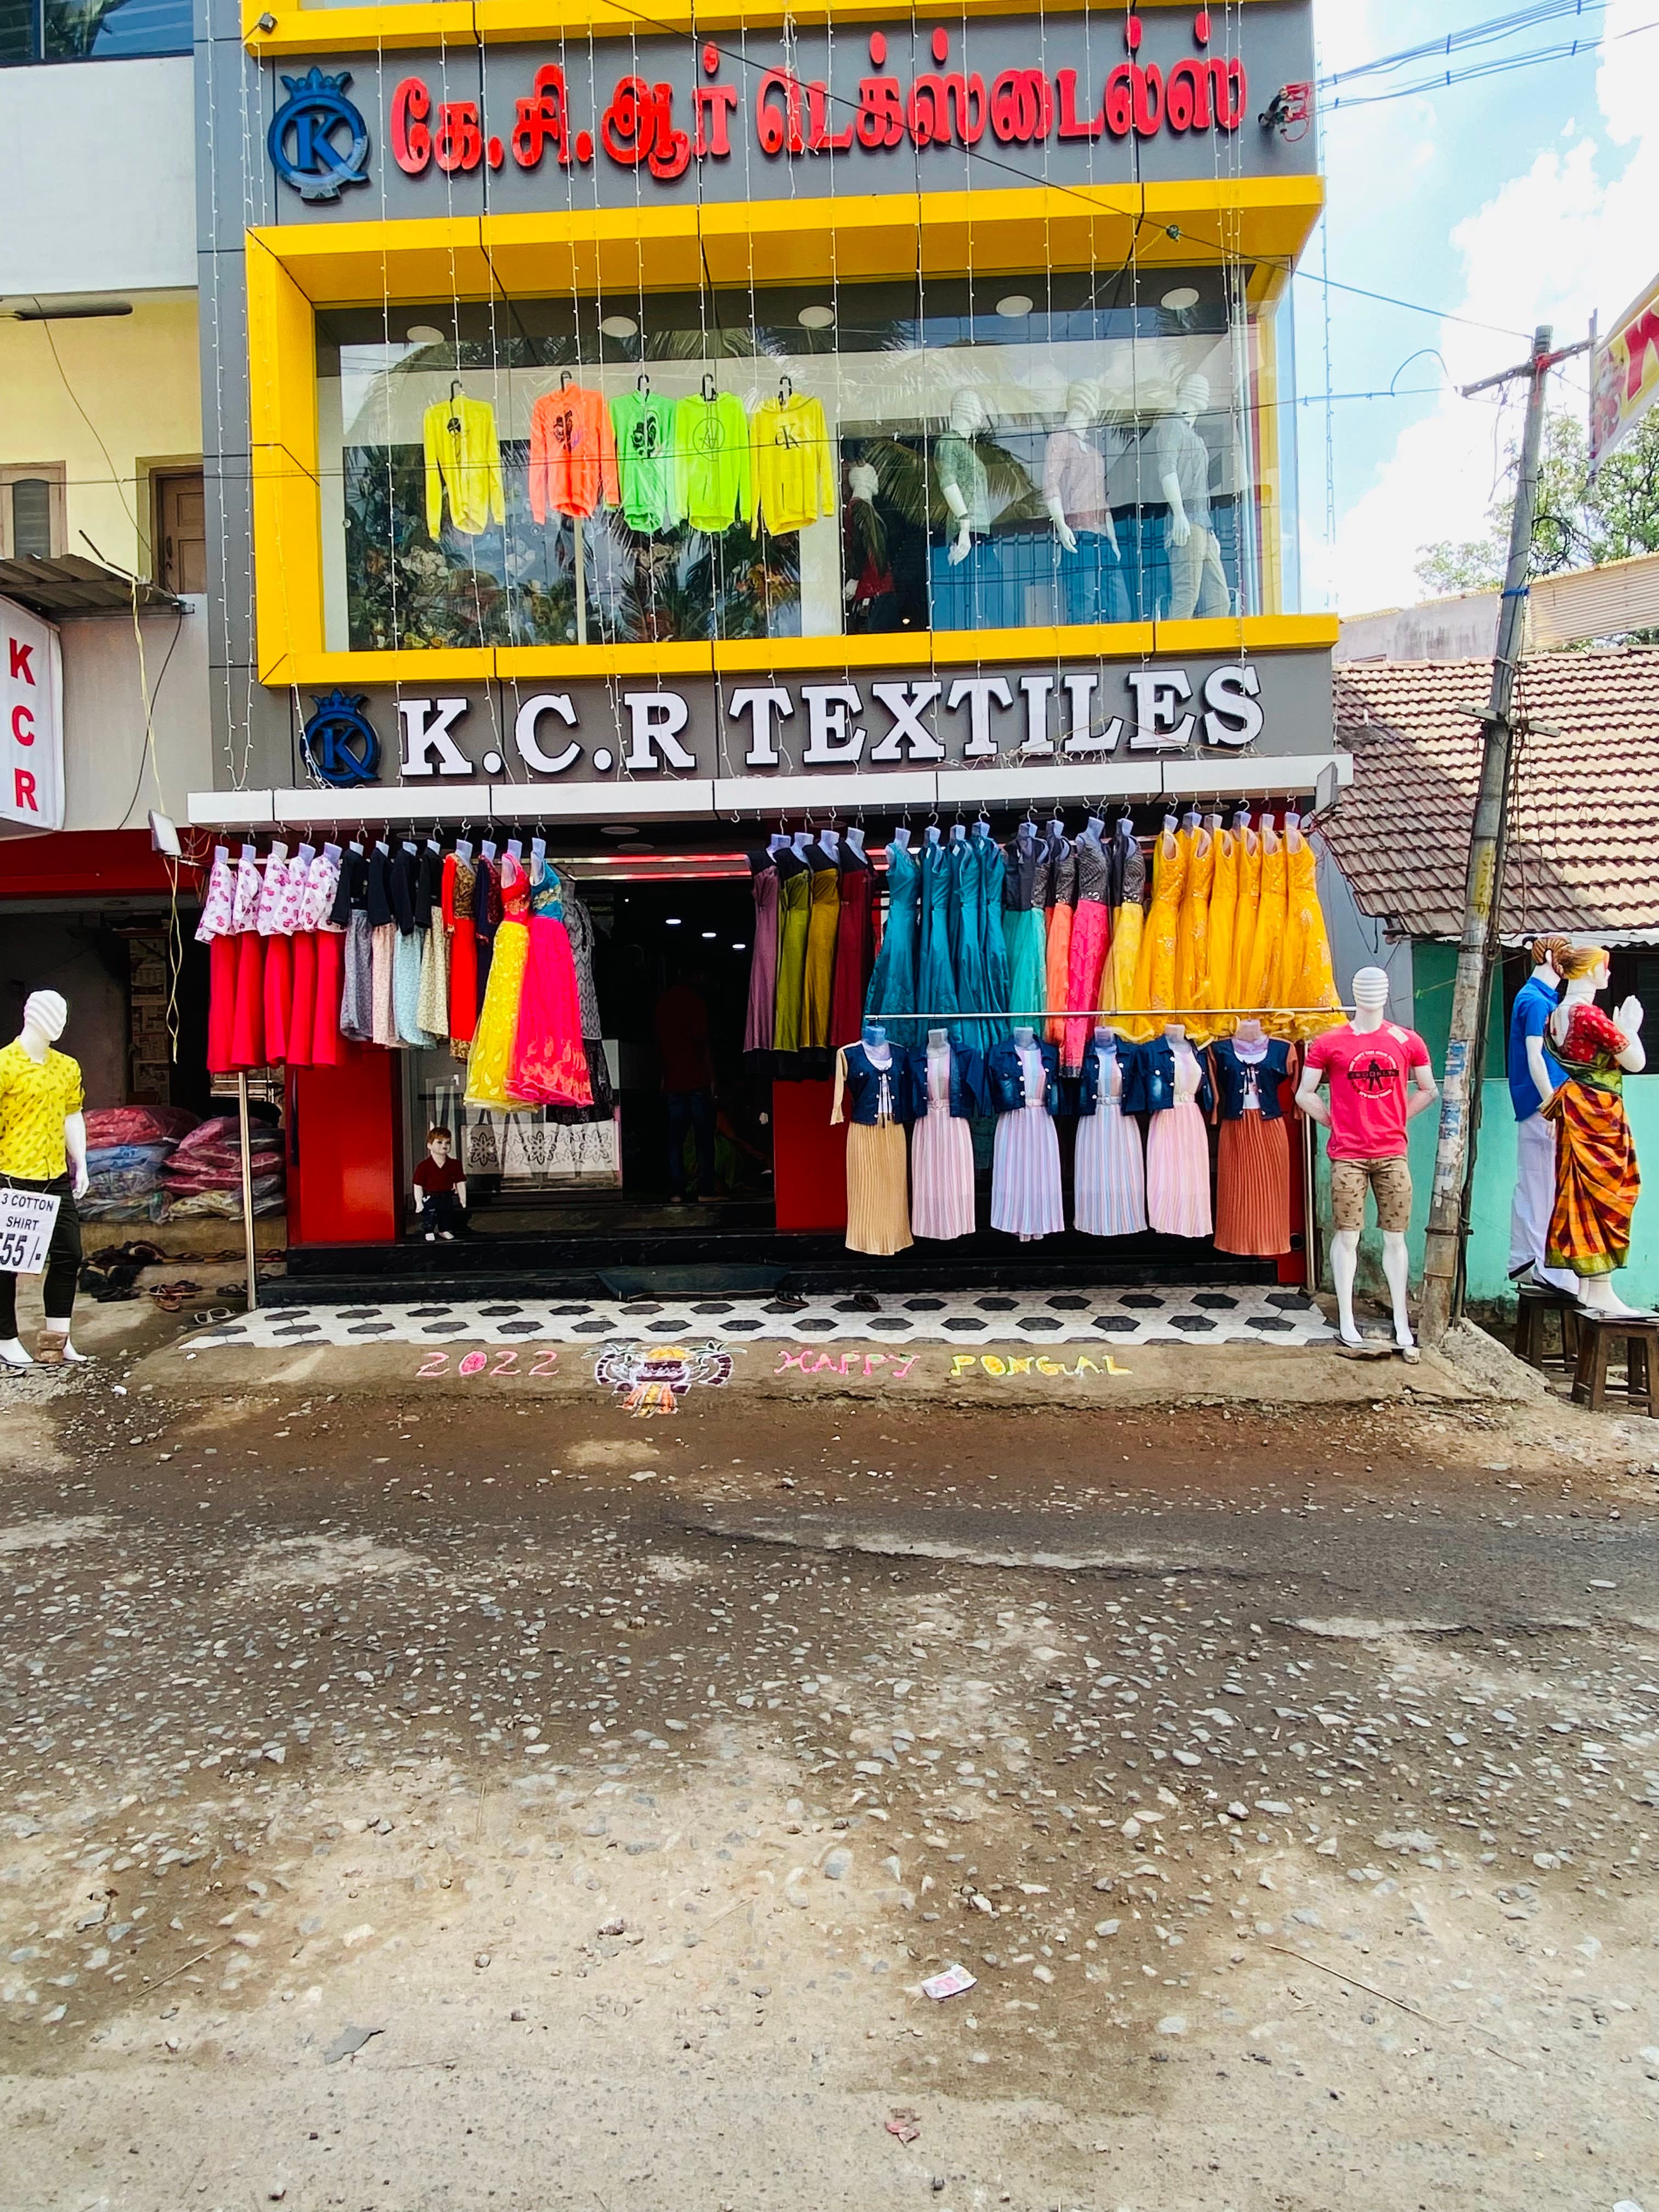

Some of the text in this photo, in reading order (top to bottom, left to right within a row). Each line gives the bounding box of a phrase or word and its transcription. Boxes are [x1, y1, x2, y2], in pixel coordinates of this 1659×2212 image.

[398, 664, 1266, 777] K.C.R TEXTILES
[2, 1193, 54, 1211] 3 COTTON
[6, 1216, 40, 1231] SHIRT
[0, 1232, 42, 1268] 55/-
[416, 1351, 560, 1377] 2022
[951, 1355, 1132, 1378] PONGAL
